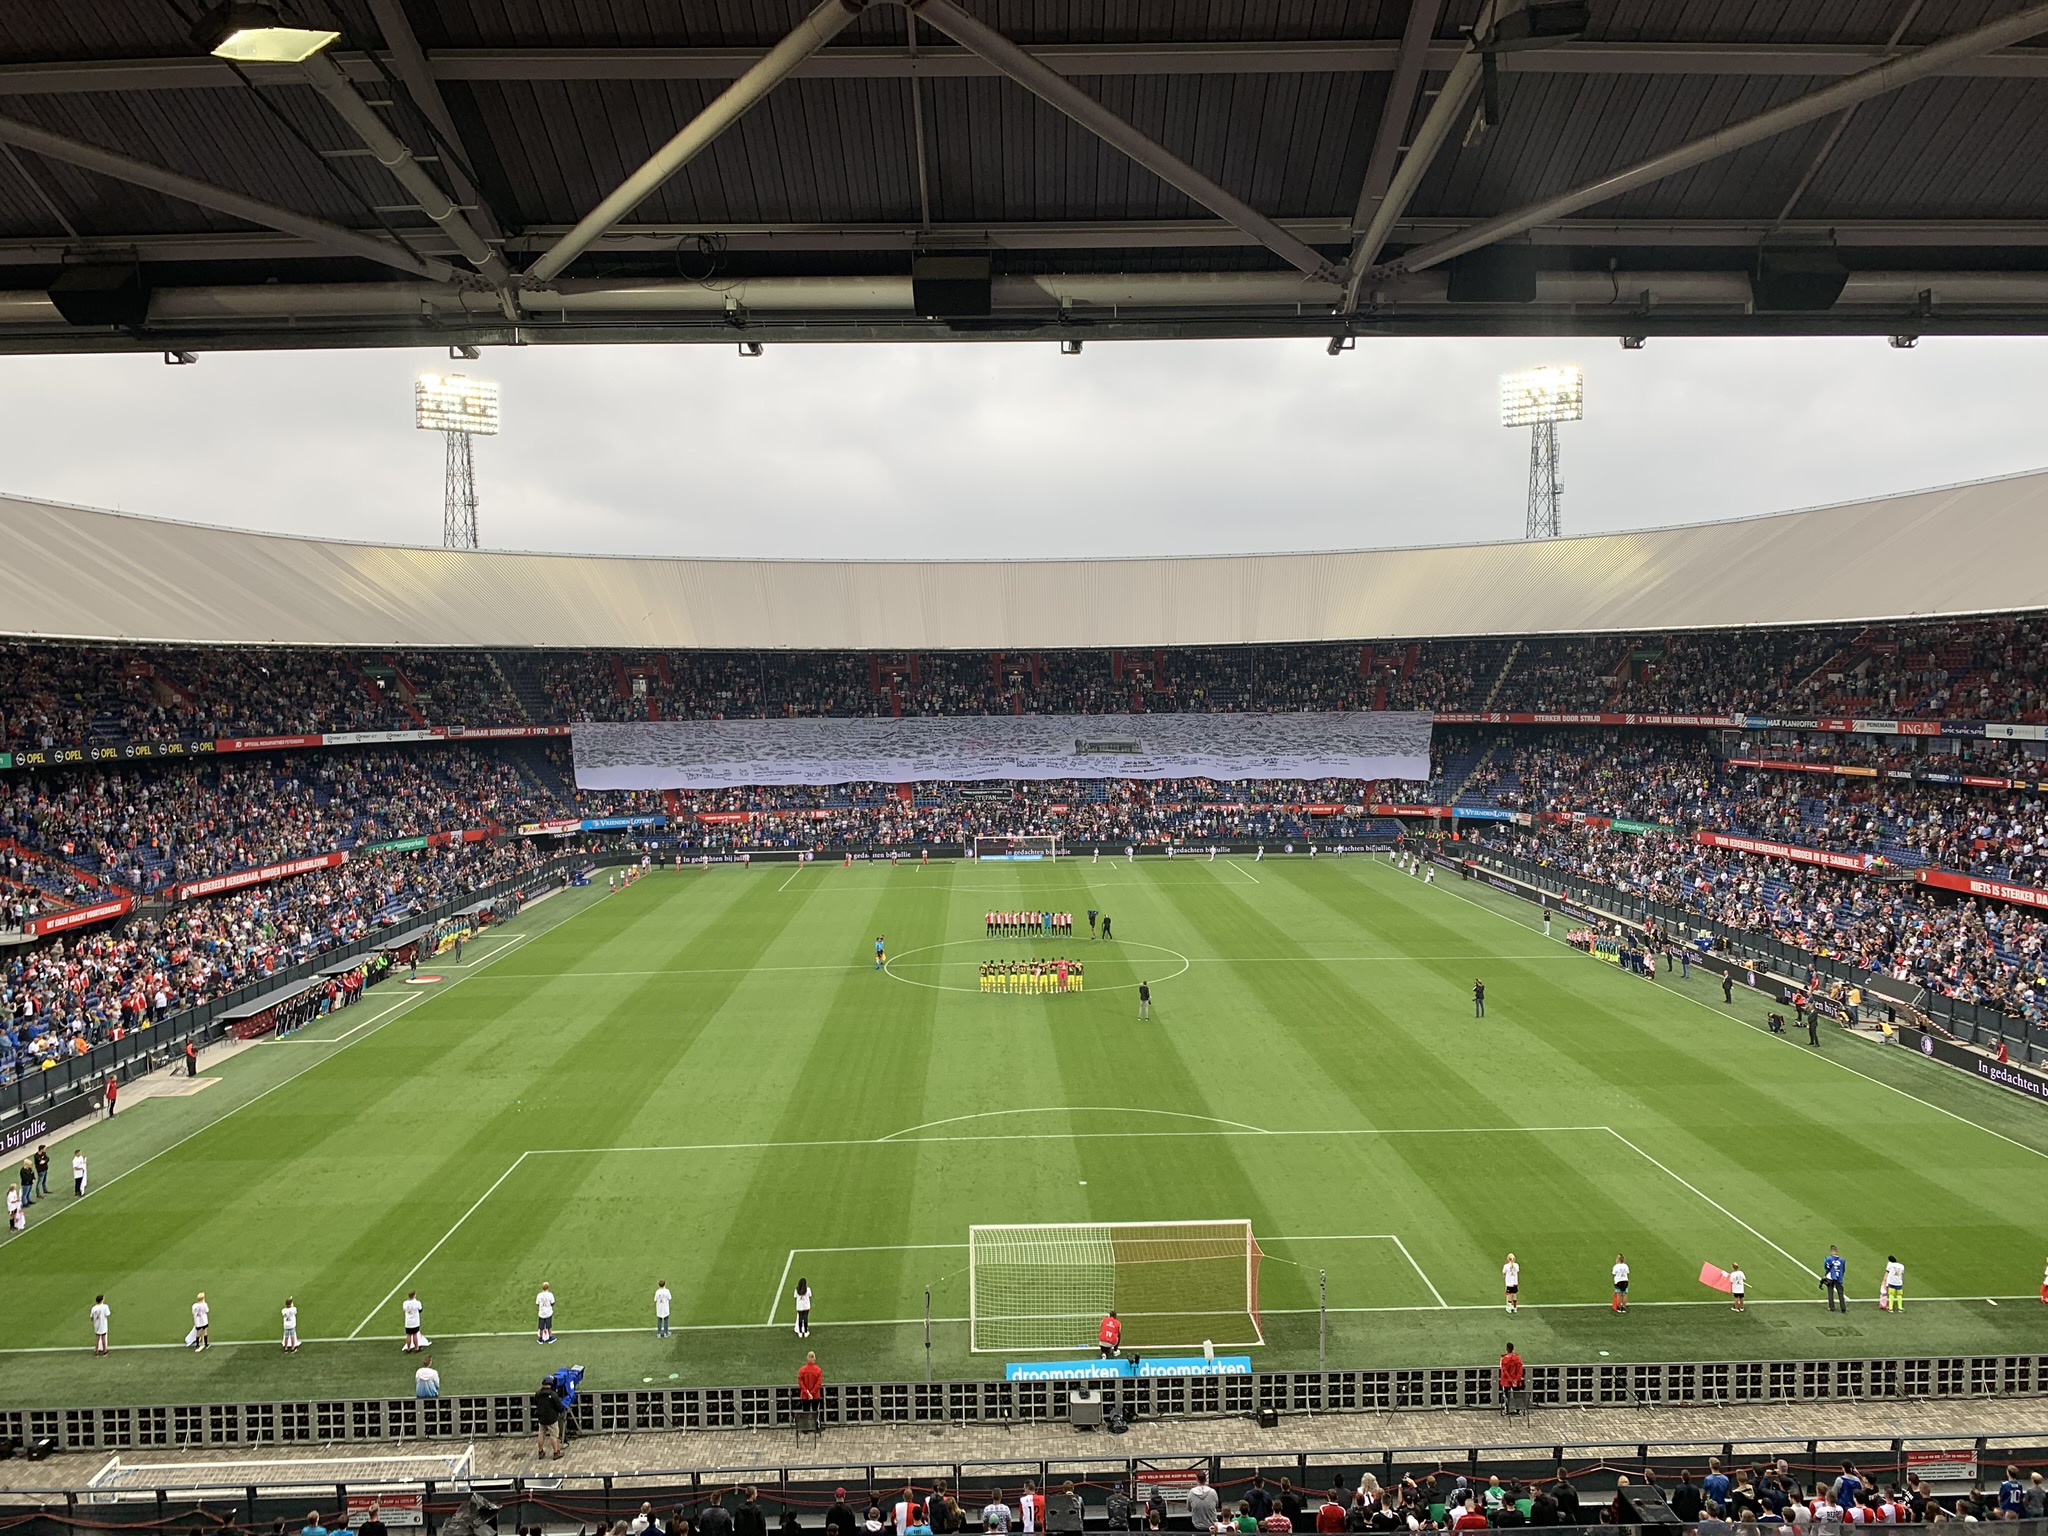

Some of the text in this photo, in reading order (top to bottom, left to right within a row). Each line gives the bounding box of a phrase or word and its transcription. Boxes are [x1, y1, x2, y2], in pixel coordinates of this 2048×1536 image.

[490, 728, 526, 736] EUROPACUP
[533, 727, 549, 735] 1970
[1902, 724, 1921, 734] ING
[135, 746, 152, 756] OPEL
[168, 743, 184, 754] OPEL
[200, 742, 214, 752] OPEL
[26, 752, 46, 764] OPEL
[64, 750, 82, 761] OPEL
[100, 748, 118, 759] OPEL
[1888, 770, 1912, 779] HELMINK
[1014, 848, 1044, 856] gedachten
[1714, 836, 1730, 846] VOOR
[1730, 838, 1754, 850] IEDEREEN
[1790, 848, 1812, 860] MIDDEN
[1813, 852, 1820, 861] IN
[1821, 854, 1830, 864] DE
[199, 878, 226, 892] IEDEREEN
[288, 864, 295, 872] DE
[1970, 880, 1992, 894] NIETS
[1992, 884, 2000, 896] IS
[2001, 886, 2035, 903] STERKER
[1978, 1060, 1988, 1074] In
[1990, 1067, 2040, 1094] gedachten
[6, 1132, 20, 1147] bij
[21, 1120, 47, 1142] jullie
[1106, 1330, 1113, 1338] TV
[1012, 1360, 1246, 1380] droomparken droomparken
[2009, 1490, 2021, 1504] 10
